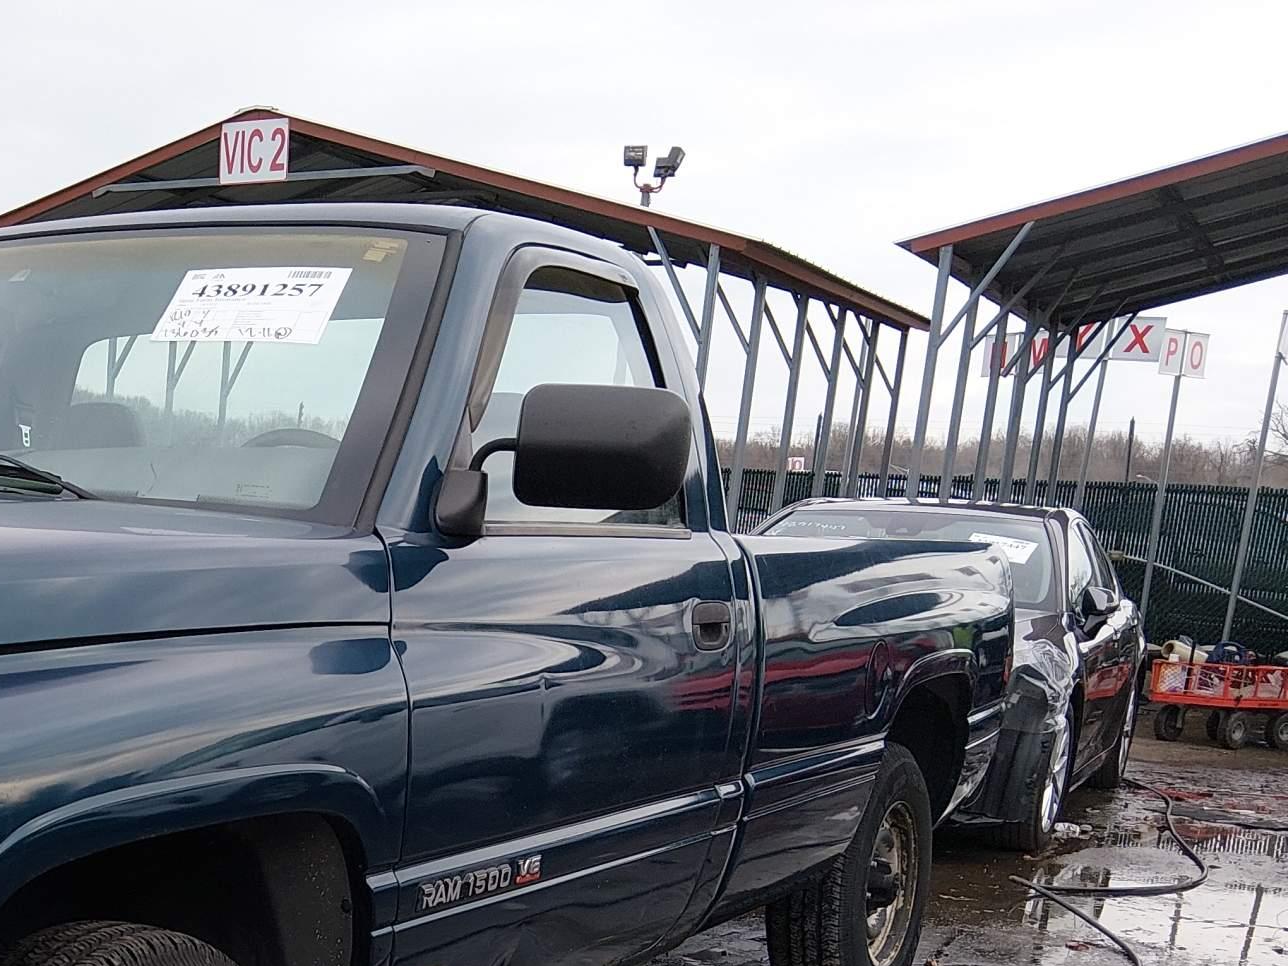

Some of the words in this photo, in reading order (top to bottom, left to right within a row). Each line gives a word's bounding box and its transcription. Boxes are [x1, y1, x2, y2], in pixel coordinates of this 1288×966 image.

[223, 128, 264, 175] VIC
[269, 127, 286, 172] 2
[192, 282, 324, 298] 43891257
[1123, 323, 1155, 354] X
[1164, 337, 1179, 366] P
[418, 876, 464, 911] RAM
[462, 863, 512, 898] 1500
